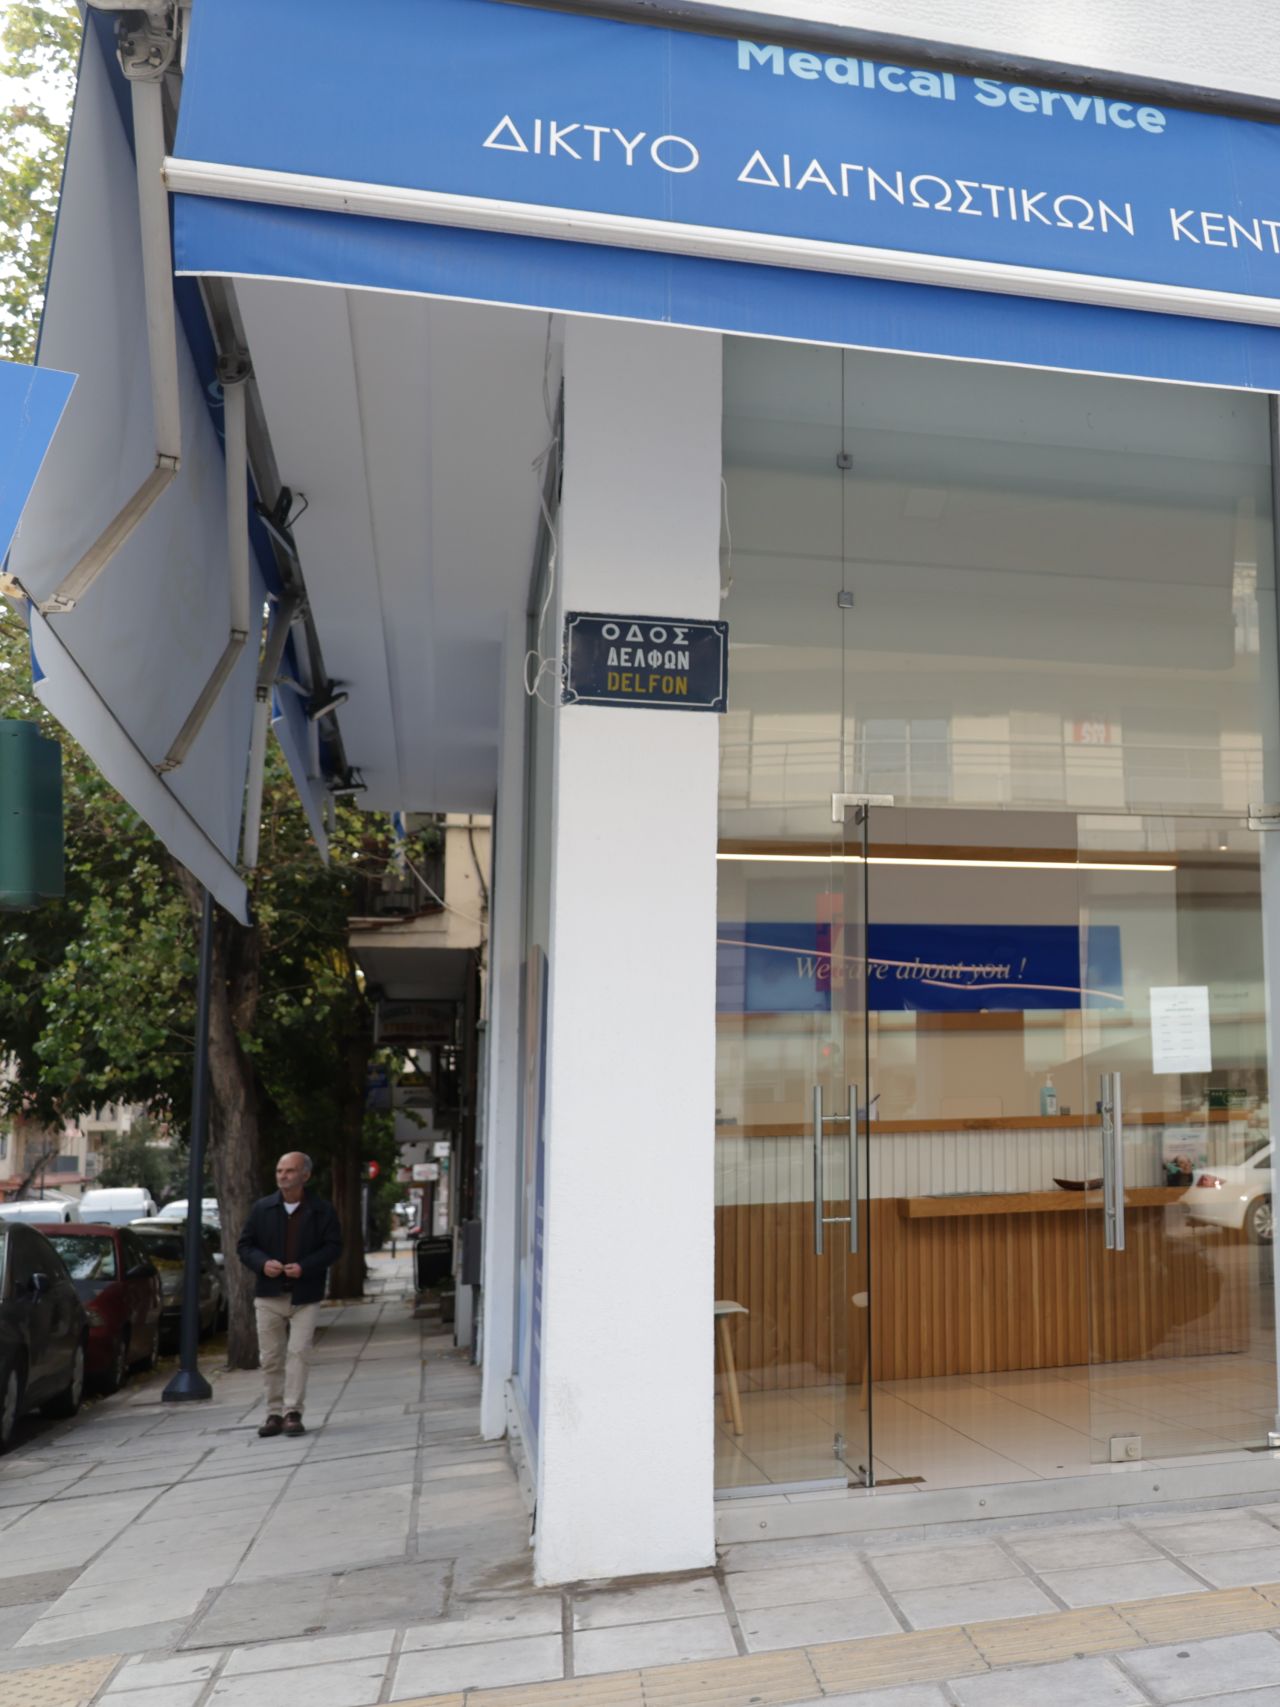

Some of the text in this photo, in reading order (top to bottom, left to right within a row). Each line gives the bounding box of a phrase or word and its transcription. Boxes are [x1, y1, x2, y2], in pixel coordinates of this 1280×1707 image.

[738, 40, 1167, 134] Medical Service
[481, 115, 700, 174] ΔΙΚΤΥΟ
[738, 148, 1135, 237] ΔΙΑΓΝΩΣΤΙΚΩΝ
[602, 624, 689, 645] ΟΔΟΣ
[607, 647, 689, 670] ΔΕΛΦΩΝ
[608, 672, 688, 695] DELFON
[796, 956, 830, 979] We
[895, 957, 963, 980] about
